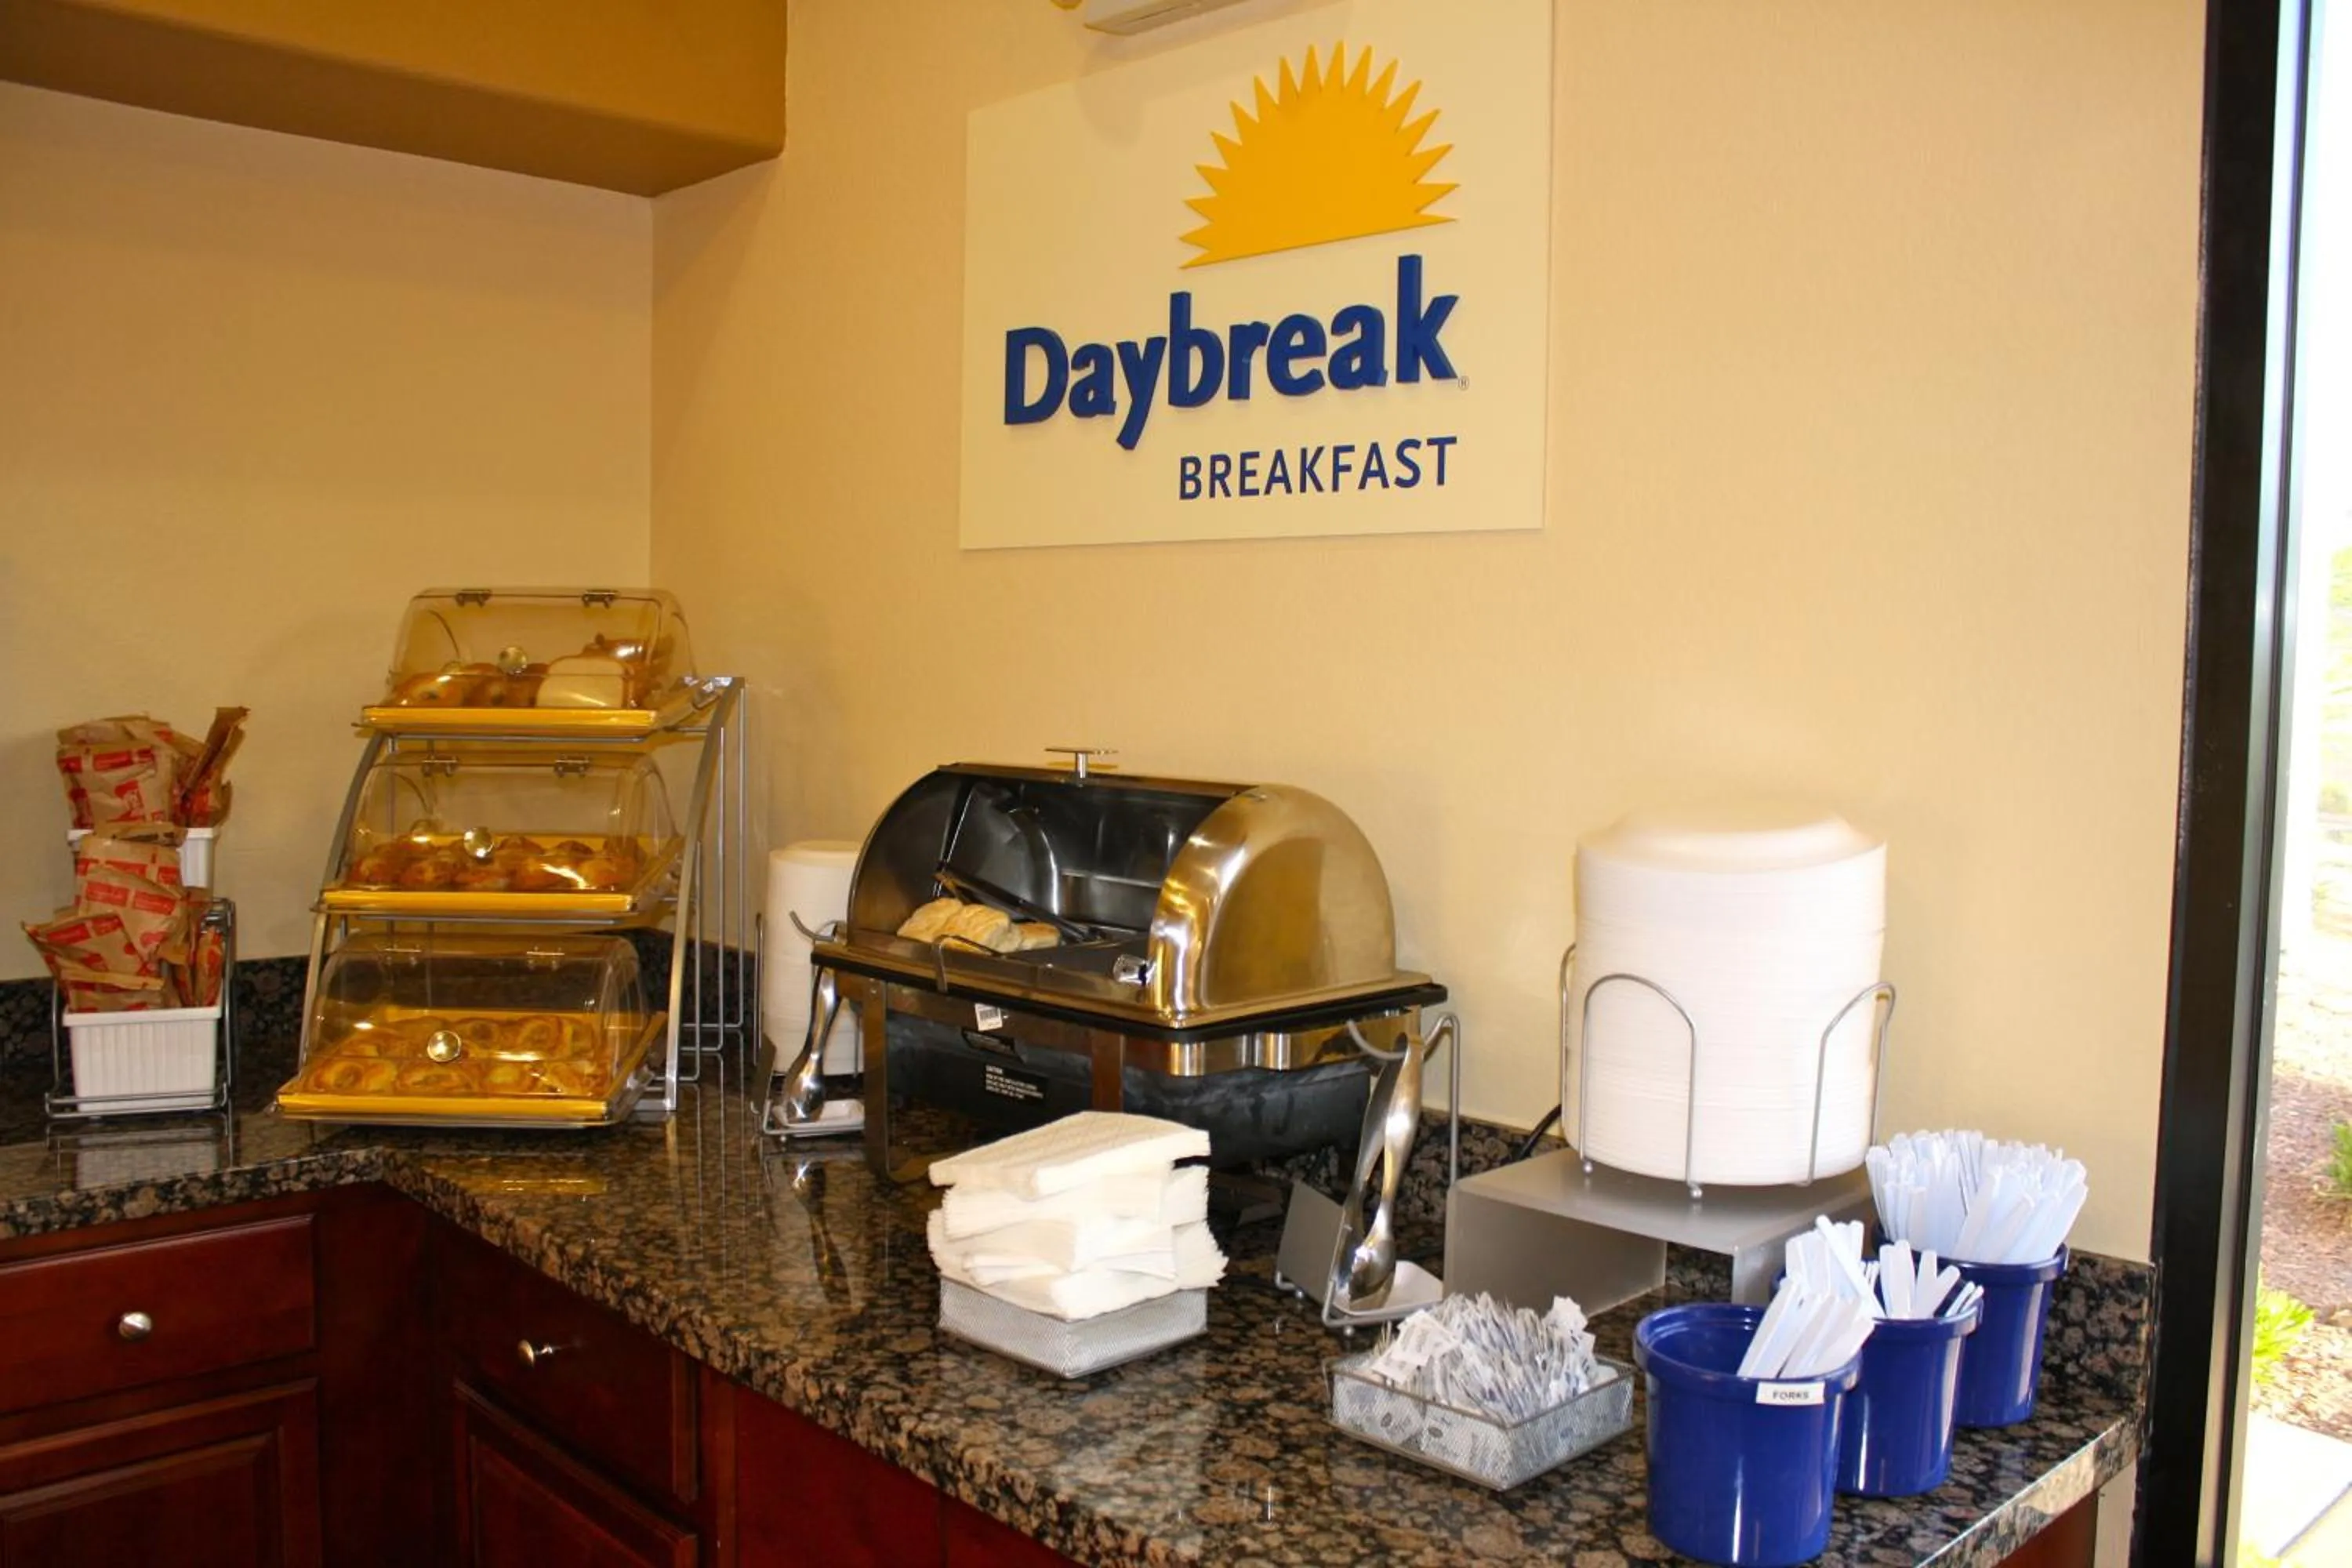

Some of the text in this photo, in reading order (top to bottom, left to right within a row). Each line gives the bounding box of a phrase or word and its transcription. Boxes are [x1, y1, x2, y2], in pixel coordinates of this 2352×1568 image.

[1004, 253, 1459, 451] Daybreak
[1178, 436, 1457, 500] BREAKFAST
[1772, 1391, 1809, 1400] FORKS
